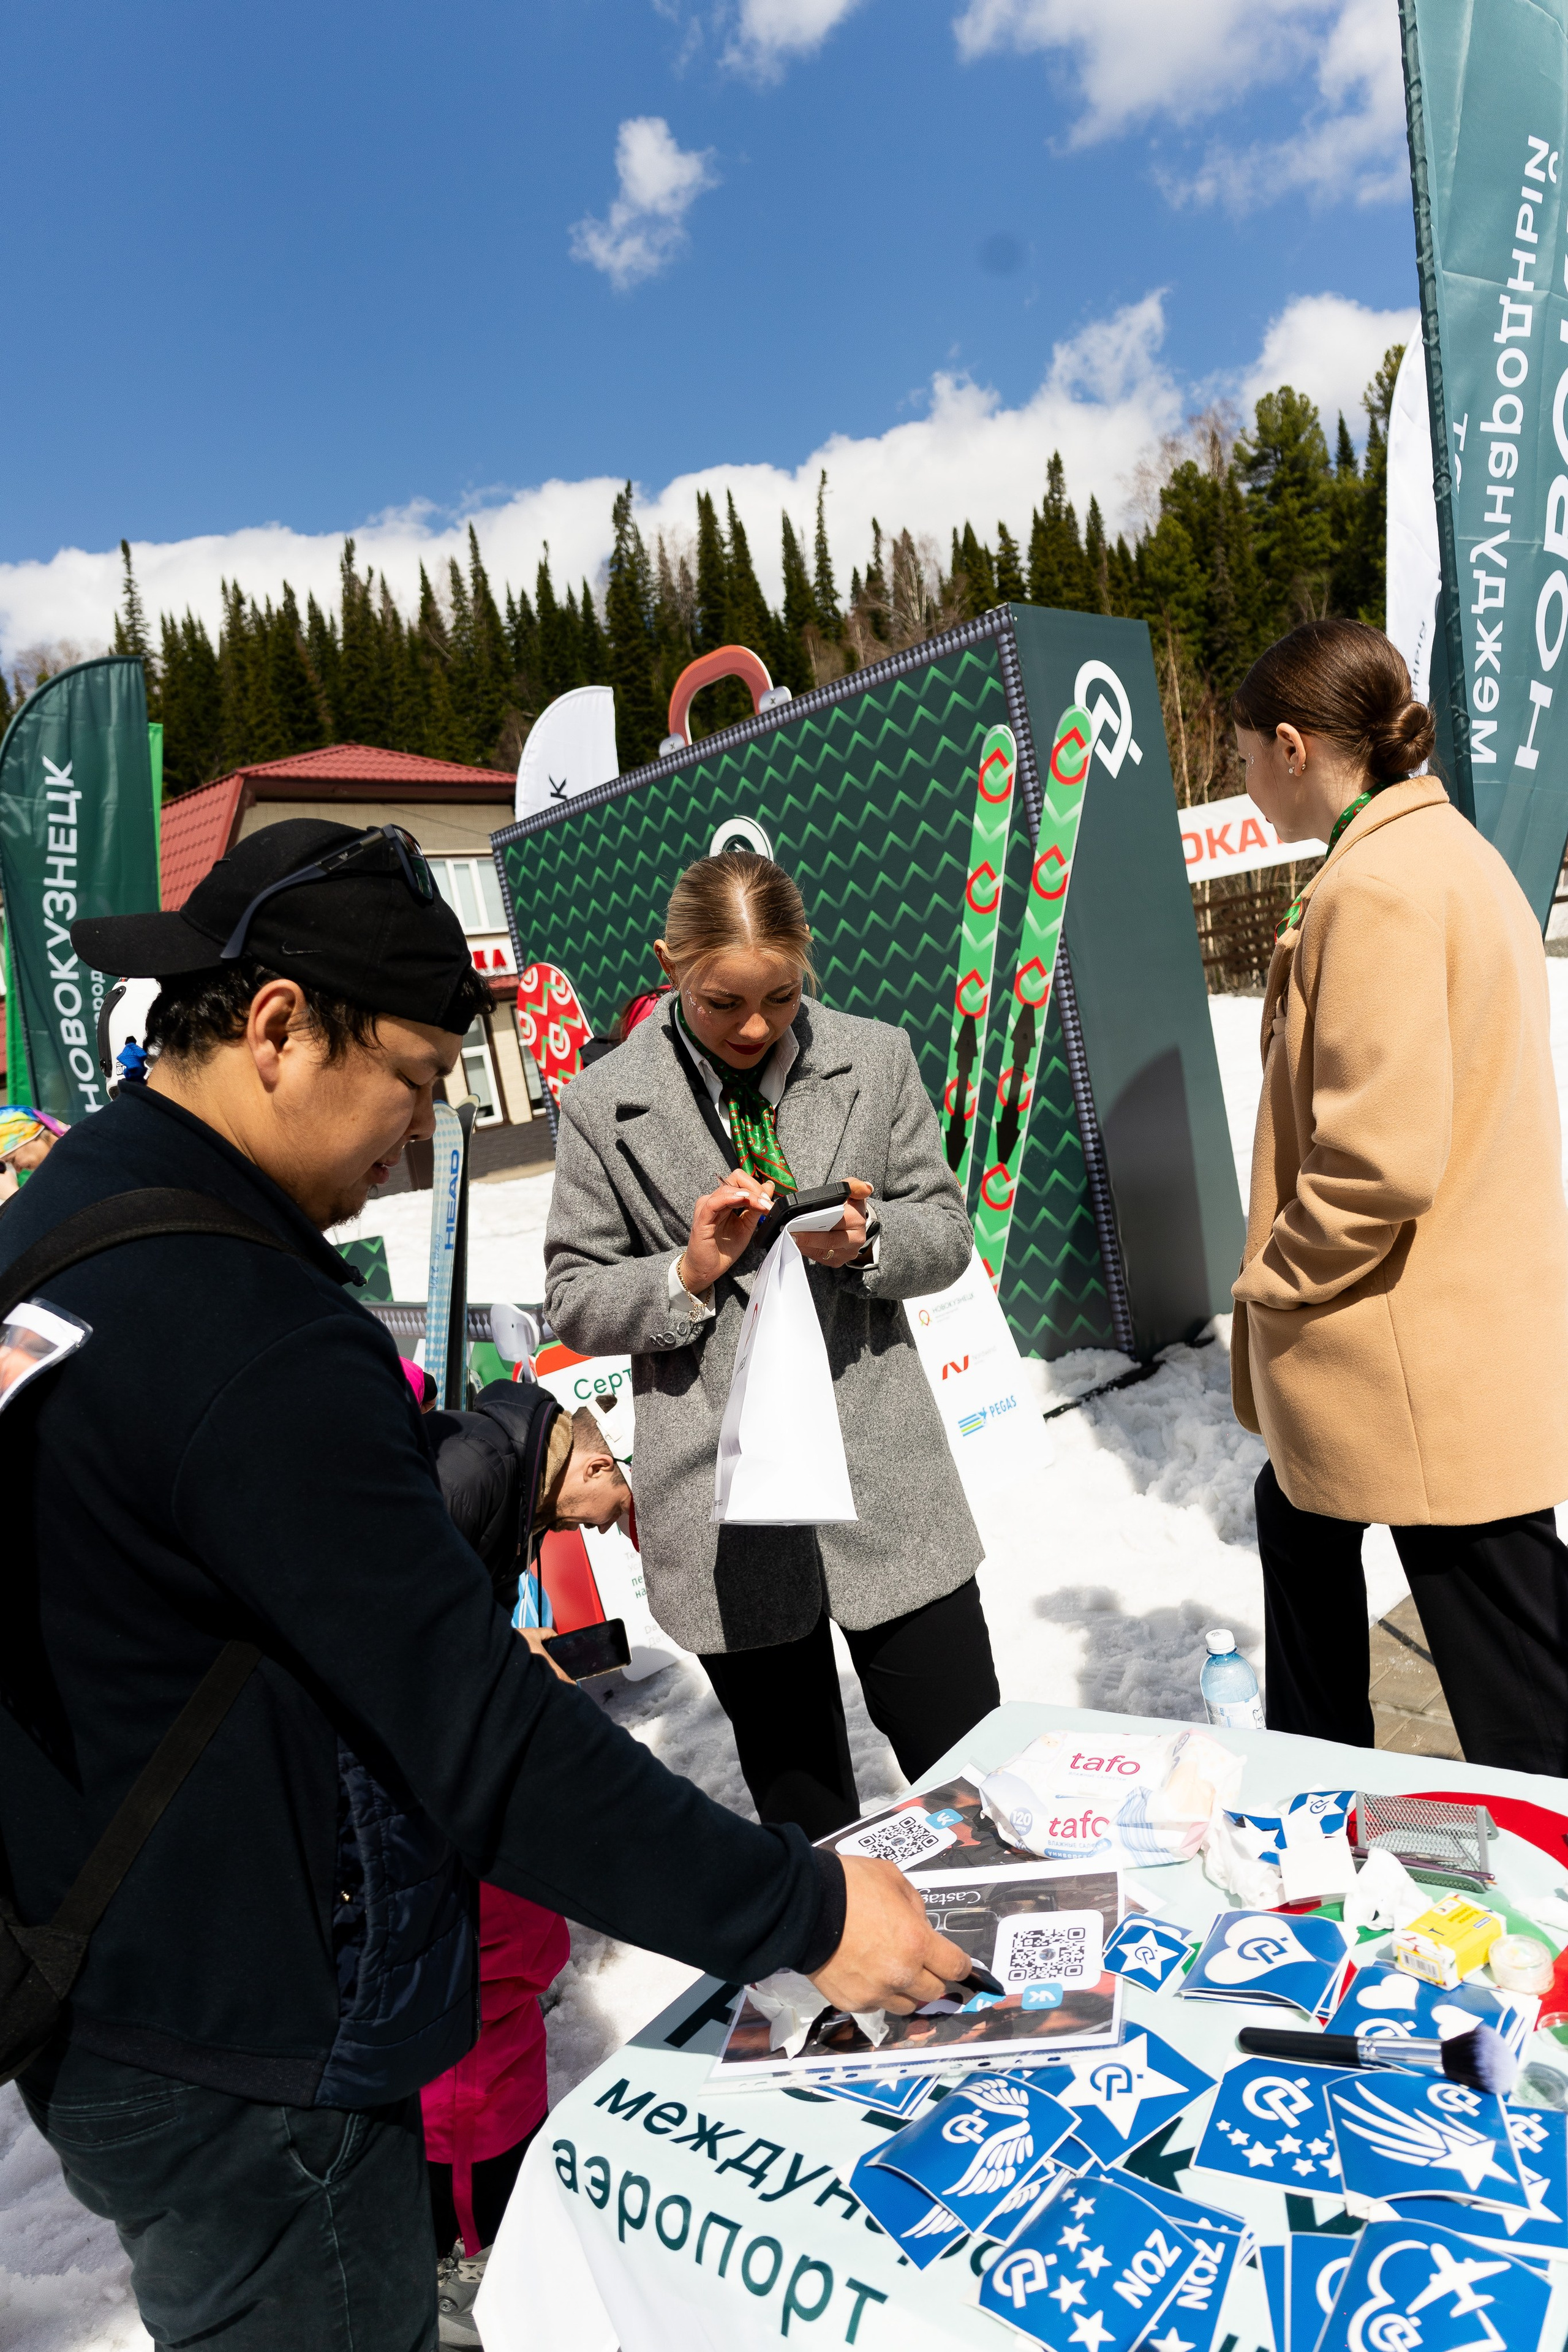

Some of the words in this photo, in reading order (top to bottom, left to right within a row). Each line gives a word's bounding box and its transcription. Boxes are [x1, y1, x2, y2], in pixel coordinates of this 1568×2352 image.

[42, 755, 104, 1114] НОВОКУЗНЕЦК
[445, 1149, 459, 1250] HEAD
[989, 1395, 1017, 1418] PEGAS
[1070, 1752, 1140, 1775] tafo
[1012, 1810, 1032, 1826] 120
[552, 2138, 888, 2345] аэропорт
[1112, 2229, 1182, 2309] NOZ
